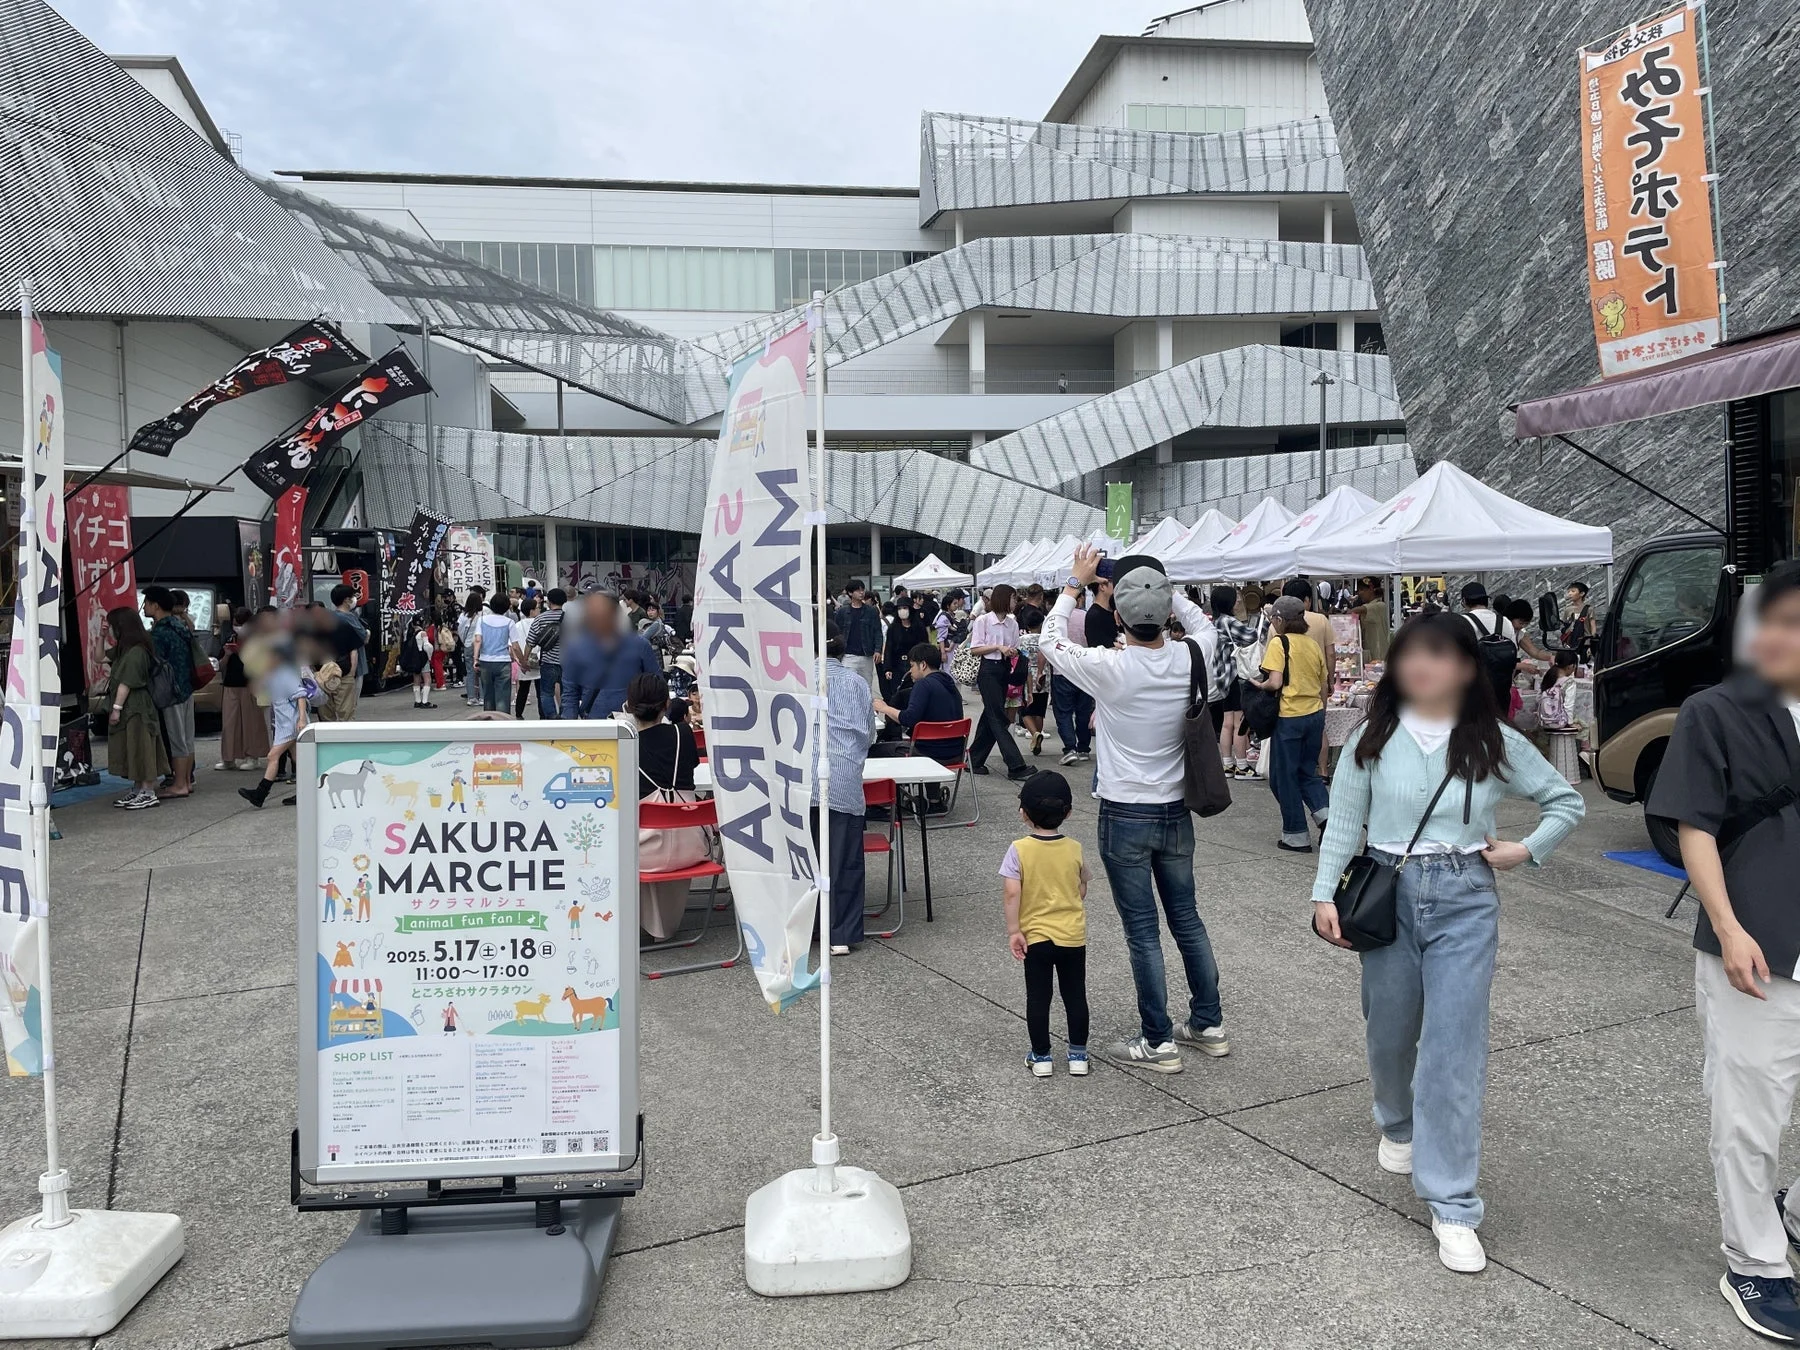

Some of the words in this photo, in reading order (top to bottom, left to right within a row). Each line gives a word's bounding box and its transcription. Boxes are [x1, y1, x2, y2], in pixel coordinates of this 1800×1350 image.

[73, 512, 129, 549] イチゴ
[291, 491, 302, 554] ラーメン
[452, 543, 463, 593] MARCHE
[463, 545, 474, 591] SAKURA
[384, 820, 558, 855] SAKURA
[378, 859, 566, 894] MARCHE
[411, 896, 526, 909] サクラマルシェ
[410, 916, 454, 930] animal
[461, 915, 484, 927] fun
[411, 985, 533, 999] ところざわサクラタウン
[334, 1052, 367, 1063] SHOP
[370, 1051, 394, 1061] LIST
